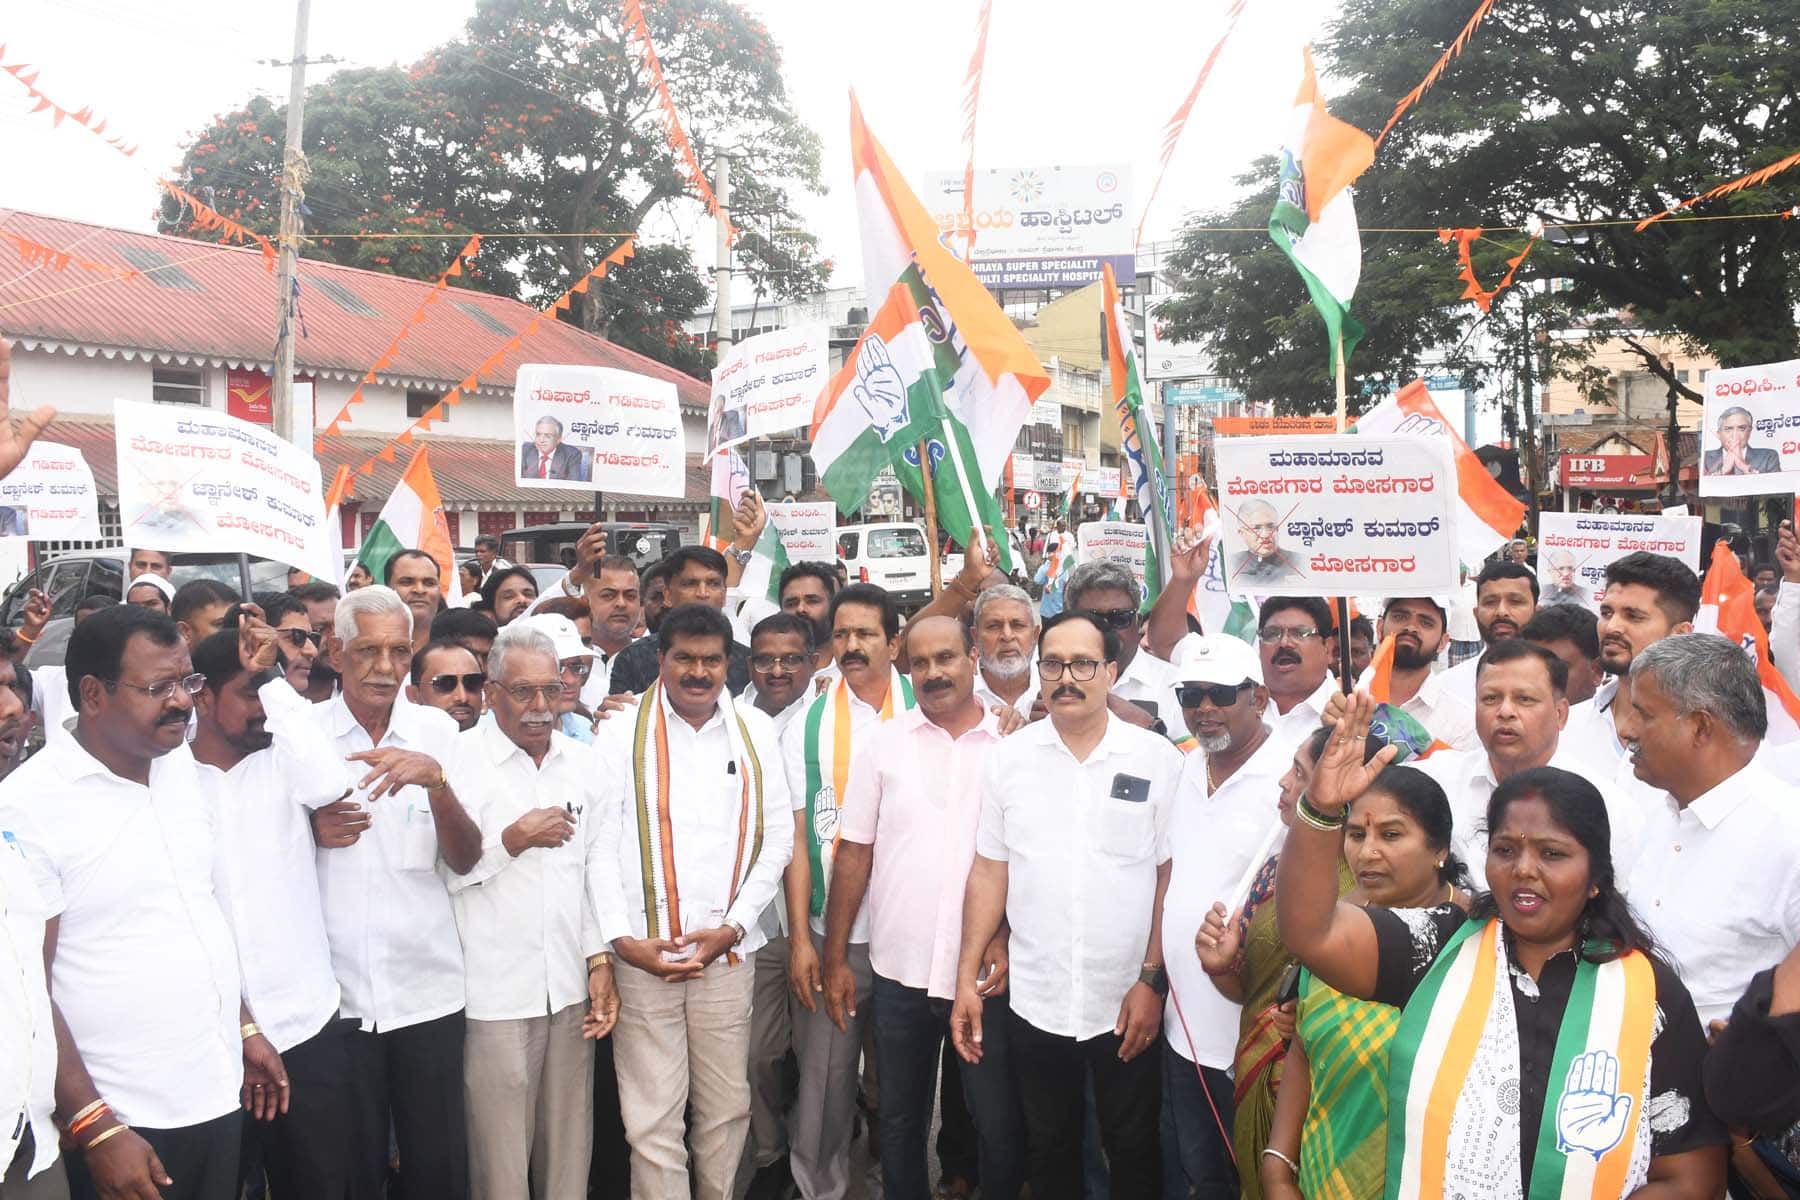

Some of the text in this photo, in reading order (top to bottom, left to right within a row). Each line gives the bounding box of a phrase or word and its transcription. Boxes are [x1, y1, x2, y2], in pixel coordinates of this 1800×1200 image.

[1020, 203, 1122, 234] ಹಾಸ್ಪಿಟಲ್
[972, 260, 1098, 273] HRAYA SUPER SPECIALITY
[1003, 272, 1060, 283] SPECIALITY
[1062, 271, 1104, 281] HOSPITA
[772, 364, 817, 385] ಕುಮಾರ್
[571, 420, 678, 442] ಜ್ಞಾನೇಶ್ ಕುಮಾರ್
[1756, 413, 1800, 438] ಜ್ಞಾನೇಶ
[176, 420, 279, 457] ಮಹಾಮಾನವ
[130, 435, 312, 495] ಮೋಸಗಾರ ಮೋಸಗಾರ
[1269, 447, 1384, 468] ಮಹಾಮಾನವ
[1569, 458, 1606, 472] IFB
[49, 483, 89, 495] ಕುಮಾರ್
[1227, 472, 1435, 495] ಮೋಸಗಾರ ಮೋಸಗಾರ
[192, 481, 317, 528] ಜ್ಞಾನೇಶ್ ಕುಮಾರ್
[216, 513, 305, 550] ಮೋಸಗಾರ
[1287, 516, 1441, 548] ಜ್ಞಾನೇಶ್ ಕುಮಾರ್
[1576, 518, 1655, 533] ಮಹಾಮಾನವ
[1544, 533, 1686, 552] ಮೋಸಗಾರ ಮೋಸಗಾರ
[1310, 553, 1417, 574] ಮೋಸಗಾರ
